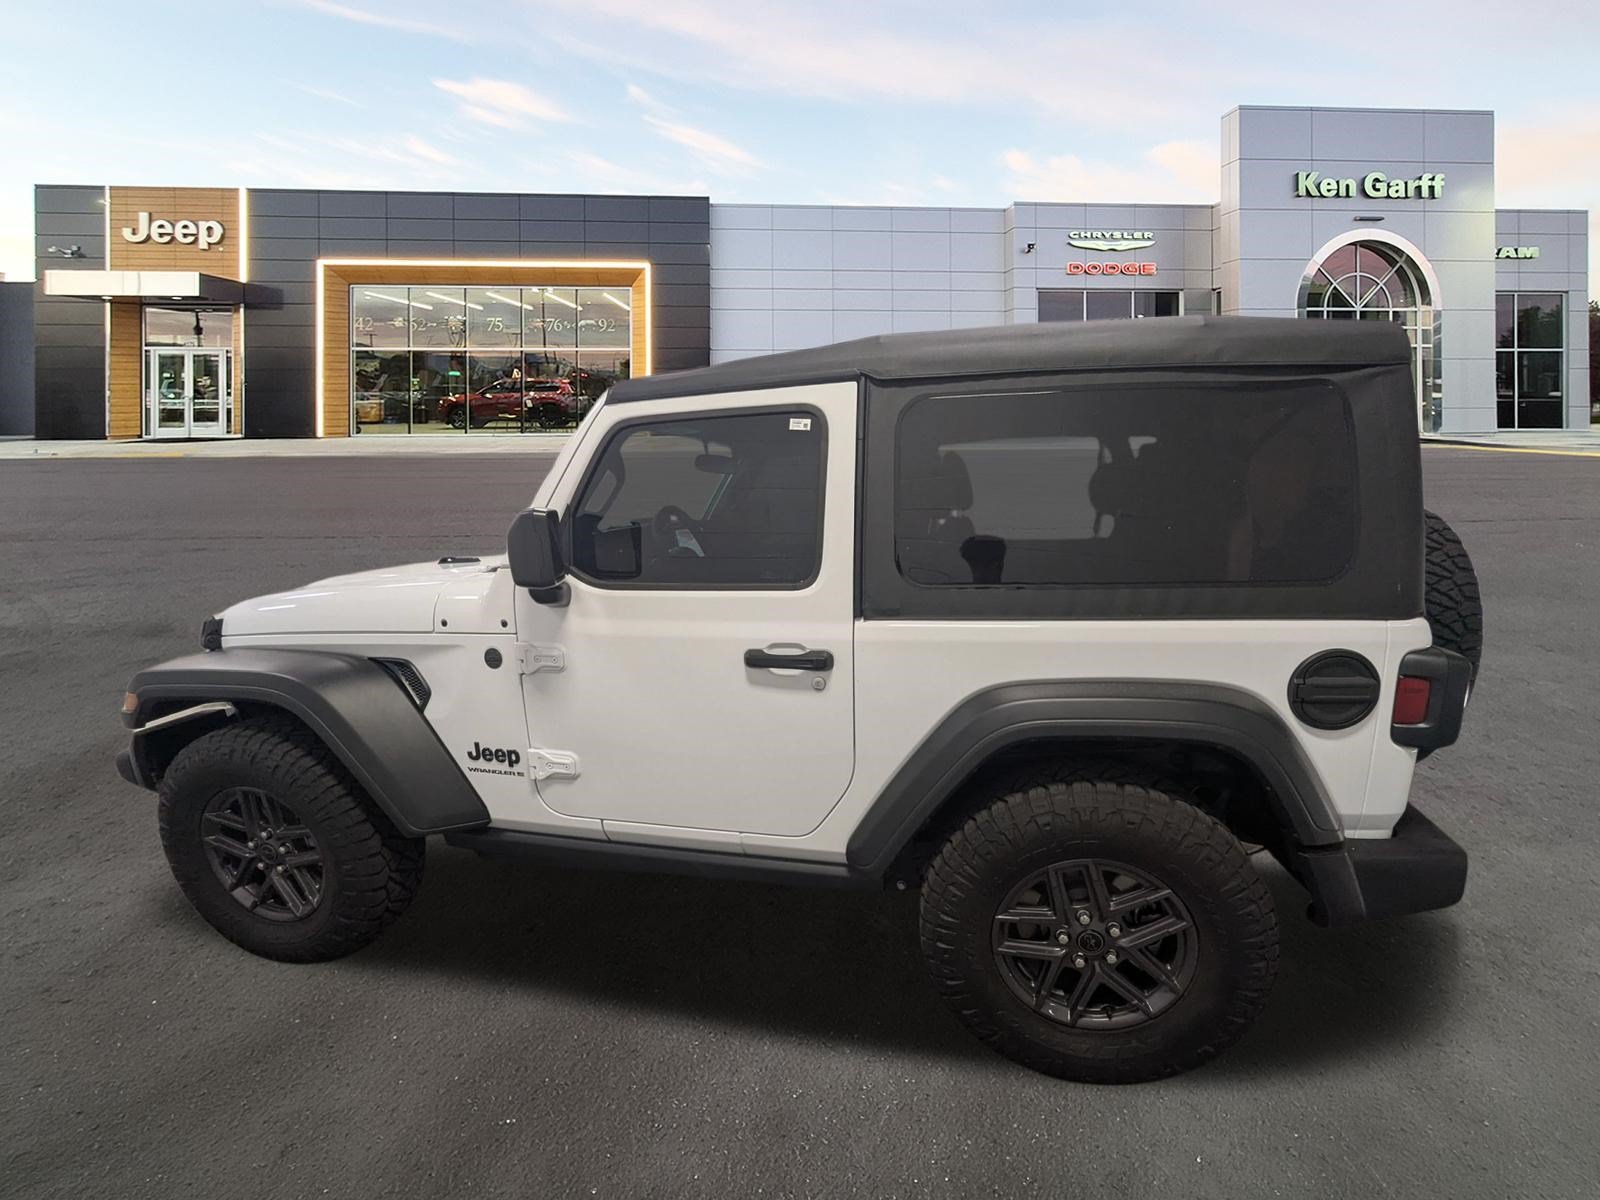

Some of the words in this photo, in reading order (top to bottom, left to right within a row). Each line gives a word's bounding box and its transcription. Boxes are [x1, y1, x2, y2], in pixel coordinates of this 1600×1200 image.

[1296, 171, 1357, 198] Ken
[1363, 171, 1446, 199] Garff
[121, 211, 224, 250] Jeep
[1069, 231, 1154, 239] CHRYSLER
[1495, 246, 1540, 259] AM
[1066, 262, 1157, 275] DODGE
[354, 317, 373, 331] 42
[486, 317, 504, 332] 75
[546, 318, 563, 332] 76
[598, 318, 616, 332] 92
[467, 741, 521, 768] Jeep
[467, 766, 516, 777] WRANGLER
